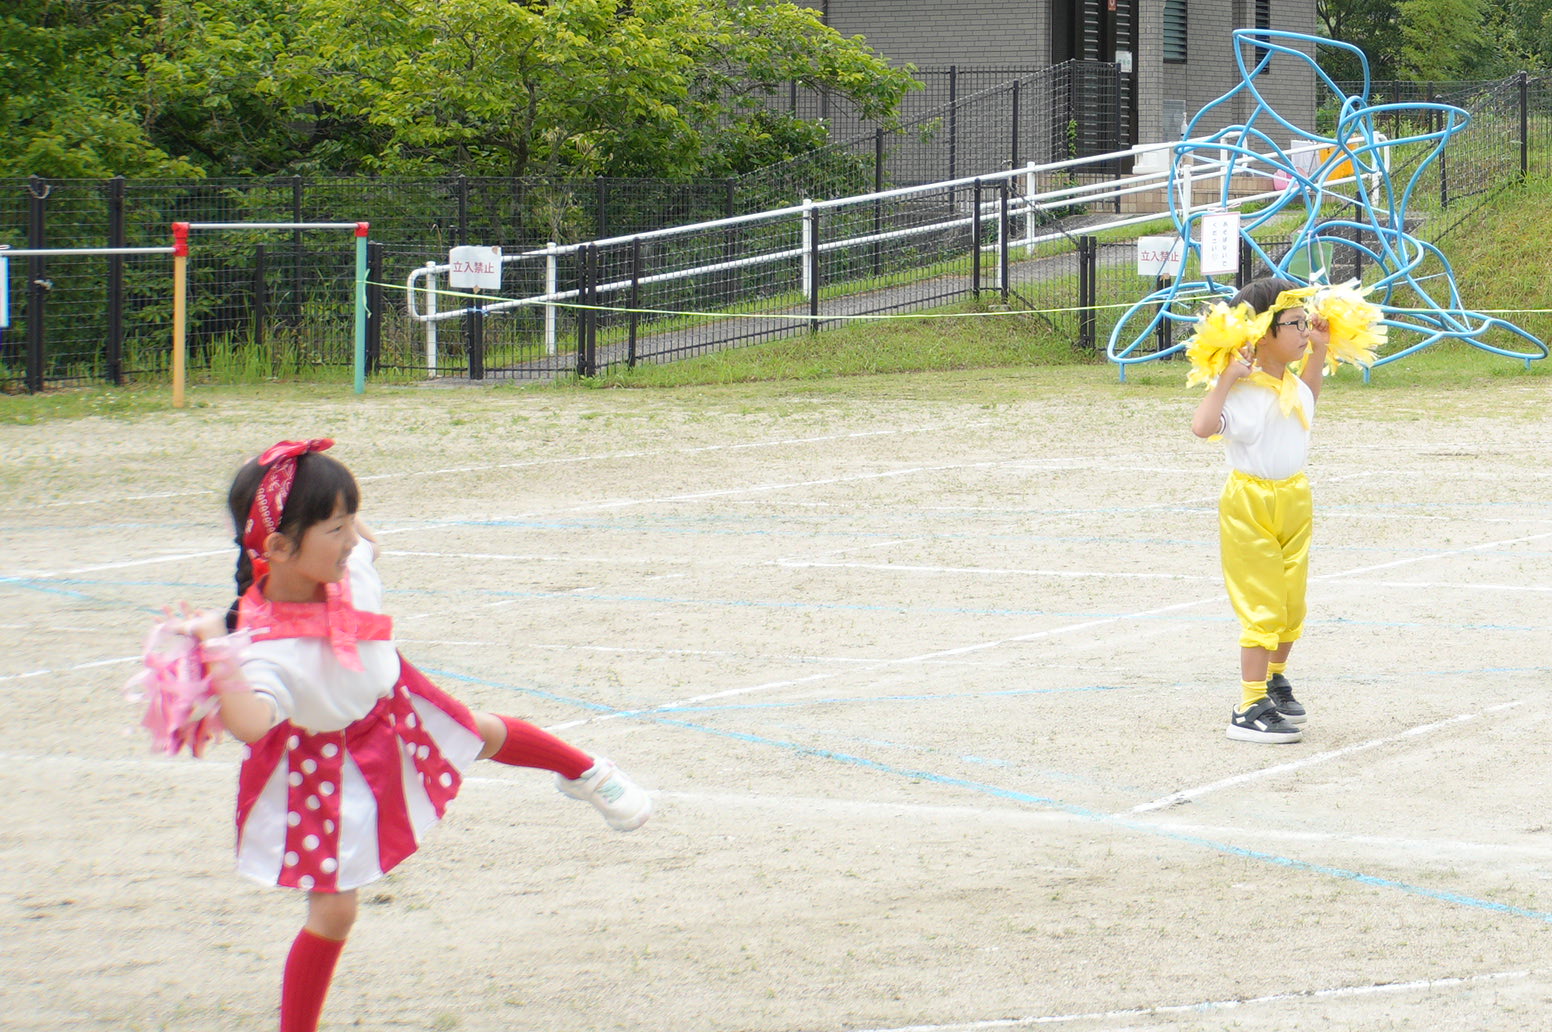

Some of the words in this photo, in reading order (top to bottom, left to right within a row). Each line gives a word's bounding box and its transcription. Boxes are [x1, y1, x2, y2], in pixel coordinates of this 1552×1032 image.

[1140, 250, 1179, 262] 立入禁止
[453, 261, 495, 274] 立入禁止
